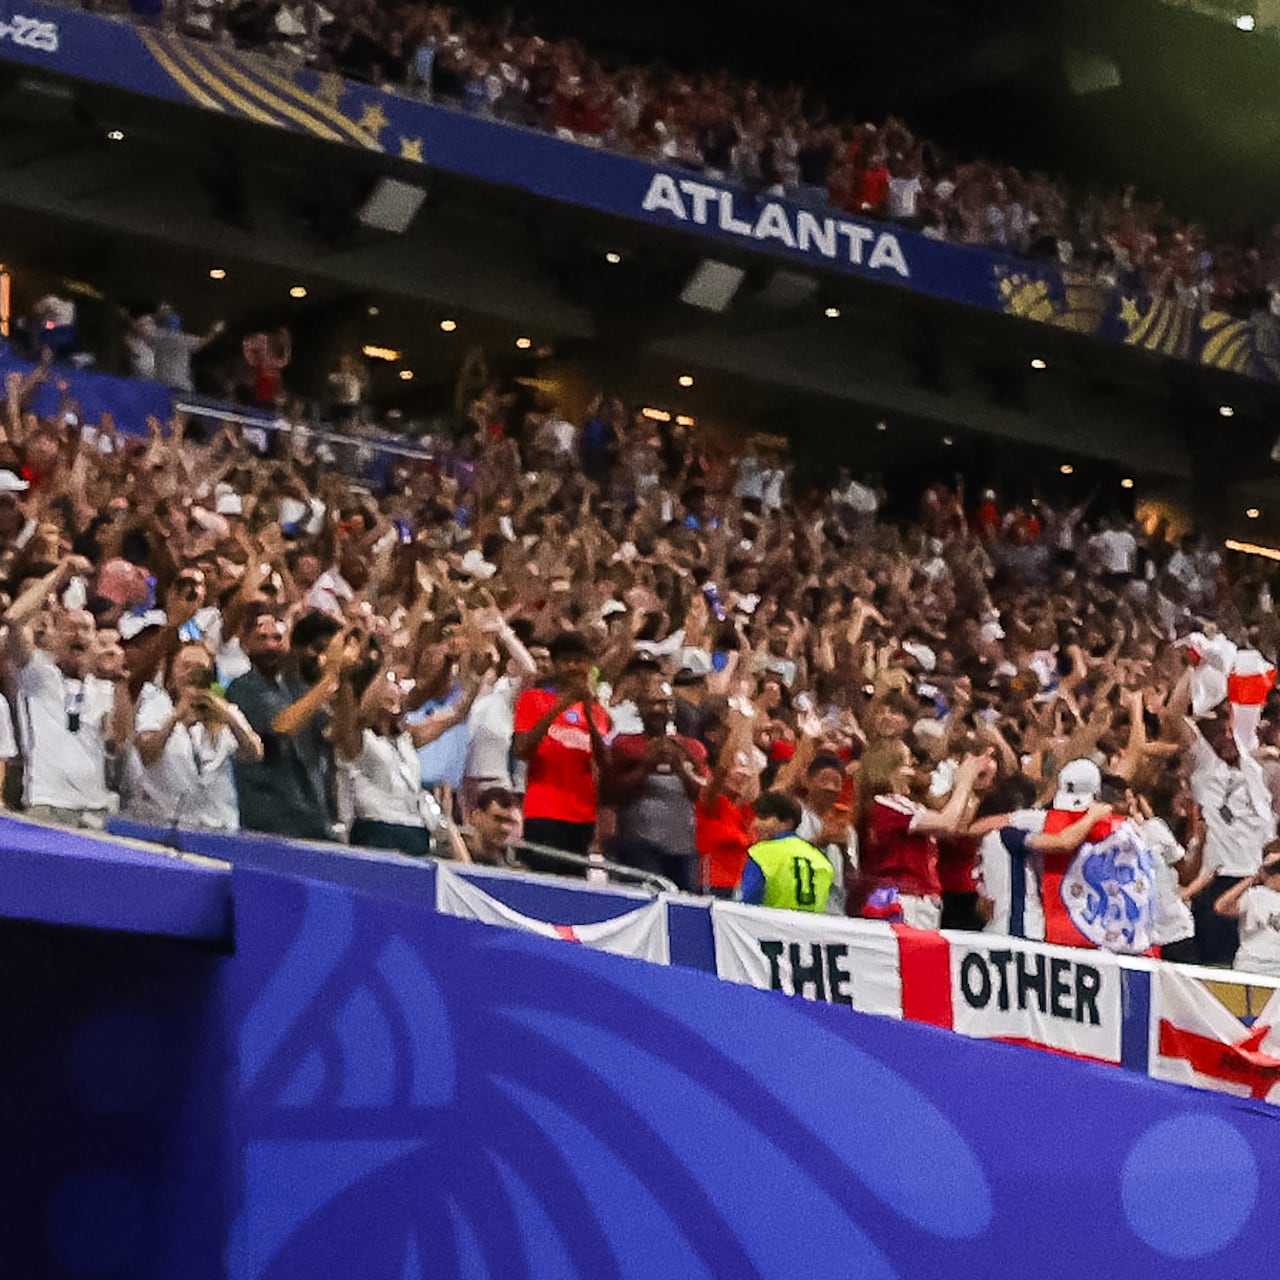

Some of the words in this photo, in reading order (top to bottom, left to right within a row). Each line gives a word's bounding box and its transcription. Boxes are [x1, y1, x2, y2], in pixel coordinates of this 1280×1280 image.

[641, 173, 909, 278] ATLANTA
[757, 937, 853, 1006] THE
[960, 949, 1101, 1026] OTHER
